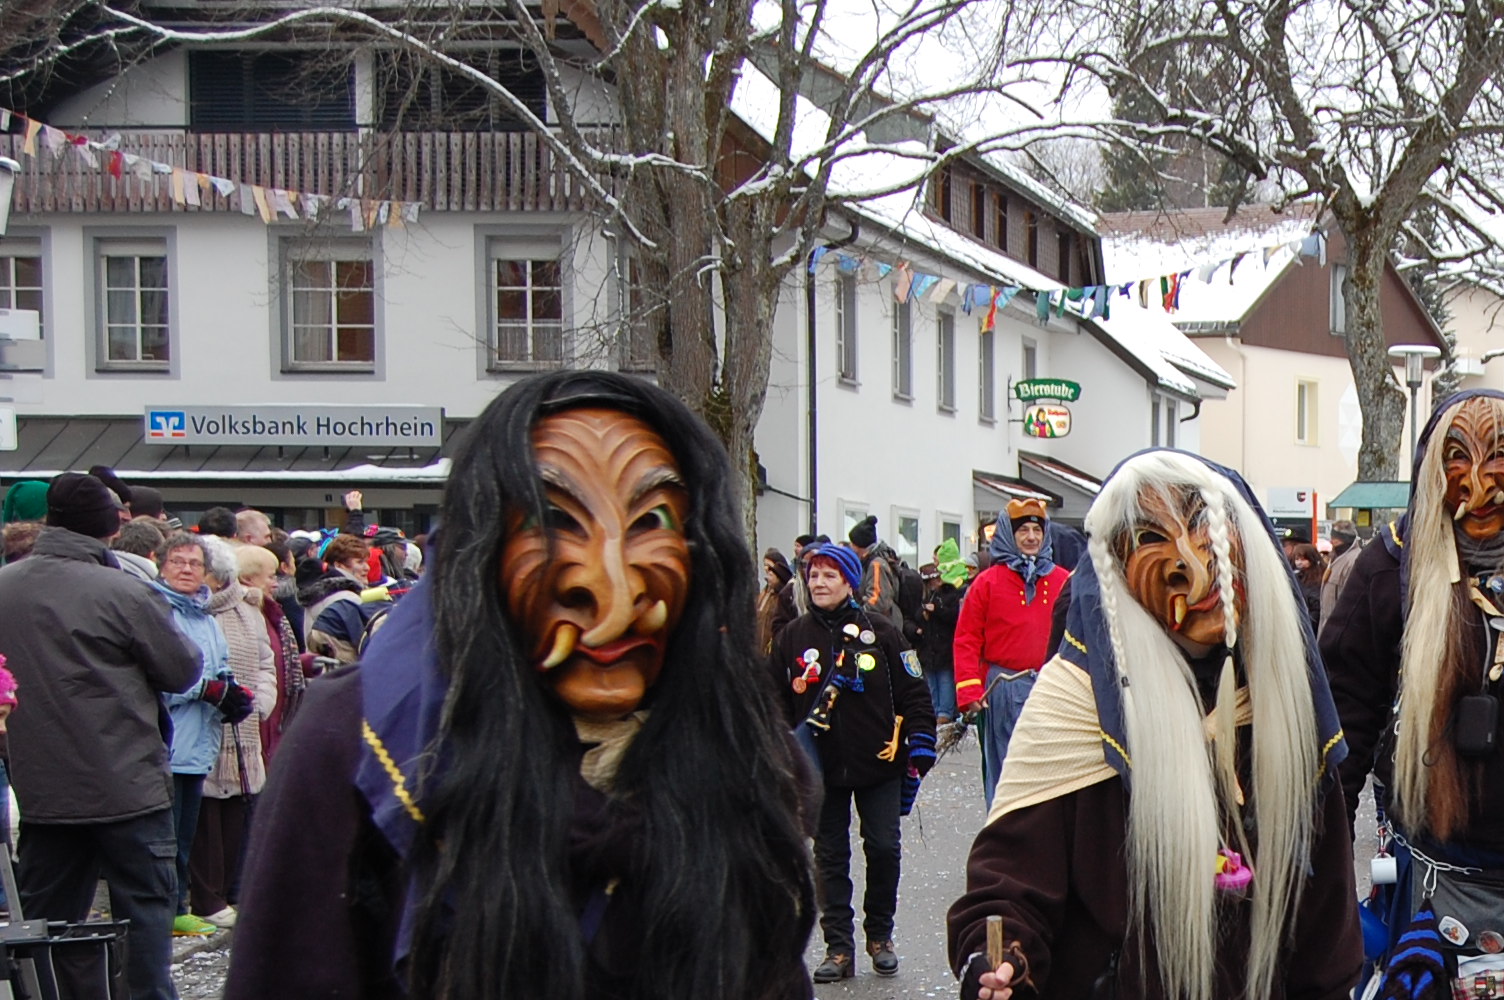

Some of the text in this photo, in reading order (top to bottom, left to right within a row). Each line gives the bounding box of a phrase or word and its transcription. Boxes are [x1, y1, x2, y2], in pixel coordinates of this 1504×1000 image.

[1018, 382, 1075, 400] Bierstube
[191, 414, 434, 437] Volksbank Hochrhein
